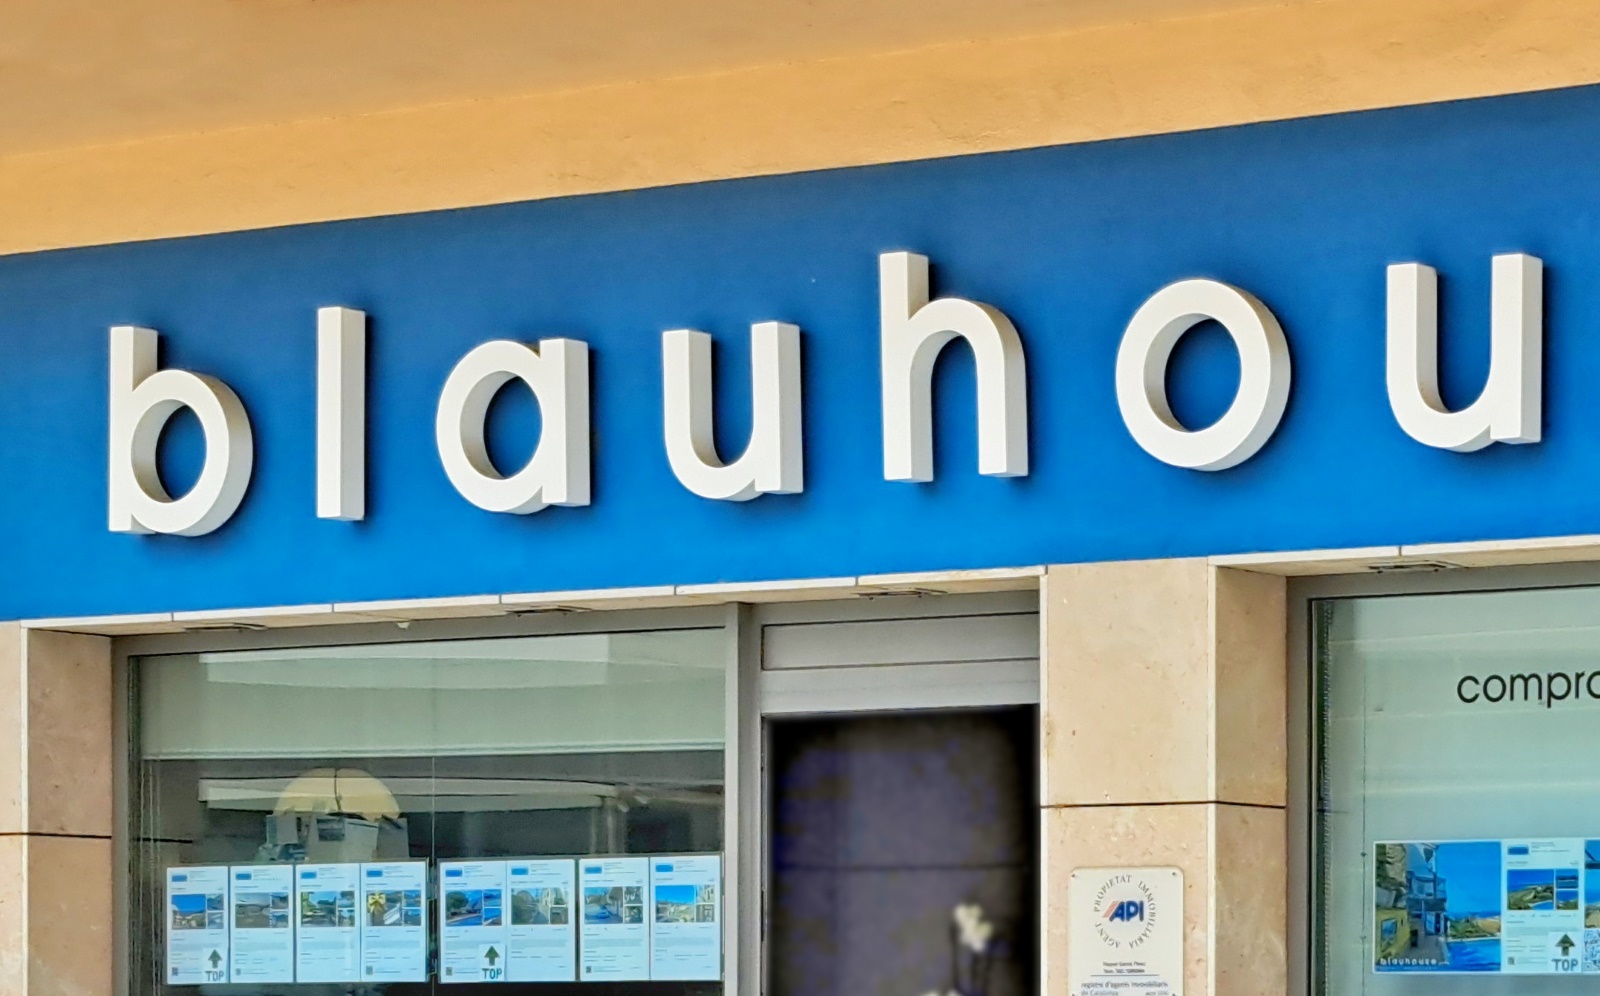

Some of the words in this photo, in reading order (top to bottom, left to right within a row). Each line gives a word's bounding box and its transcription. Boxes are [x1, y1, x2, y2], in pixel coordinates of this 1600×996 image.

[1109, 900, 1144, 922] API
[1551, 959, 1579, 972] TOP
[204, 970, 225, 982] TOP
[481, 967, 503, 980] TOP
